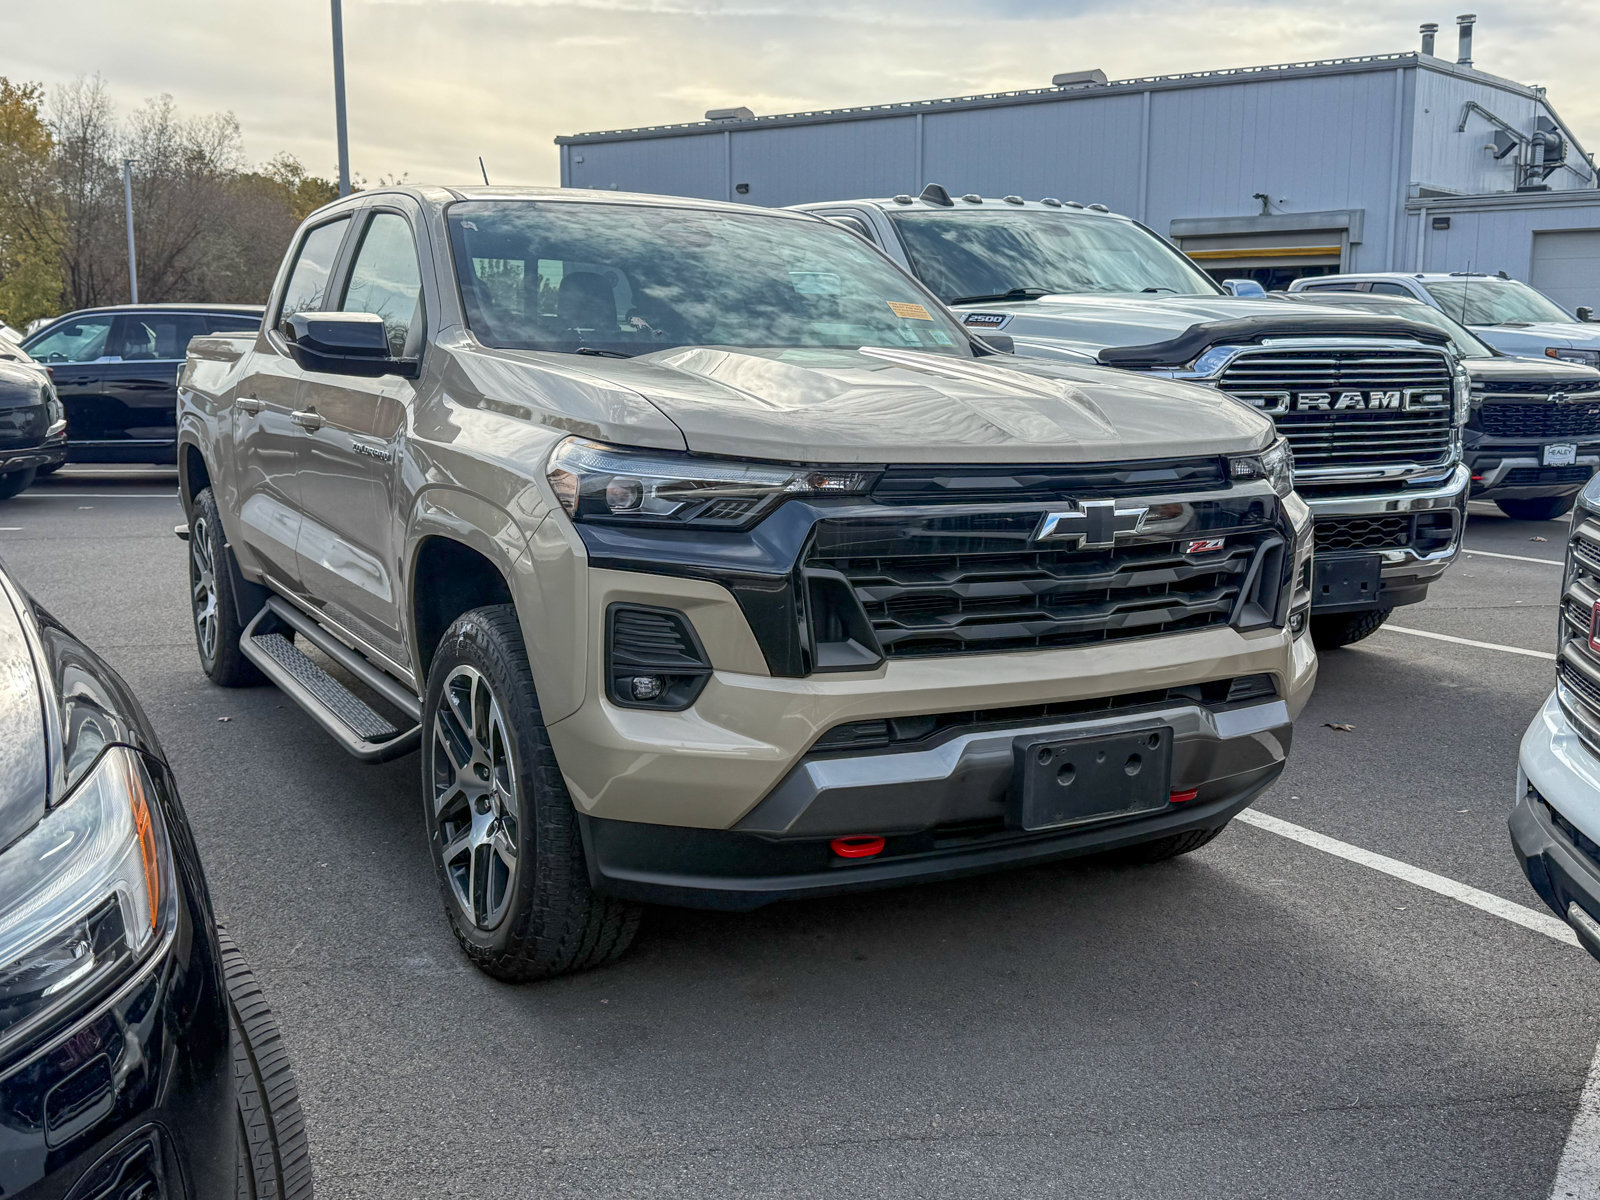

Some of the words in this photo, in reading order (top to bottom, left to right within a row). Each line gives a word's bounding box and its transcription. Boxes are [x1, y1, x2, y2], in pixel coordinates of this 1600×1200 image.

[969, 315, 1003, 323] 2500
[1297, 392, 1400, 410] RAM
[1186, 538, 1225, 553] Z71
